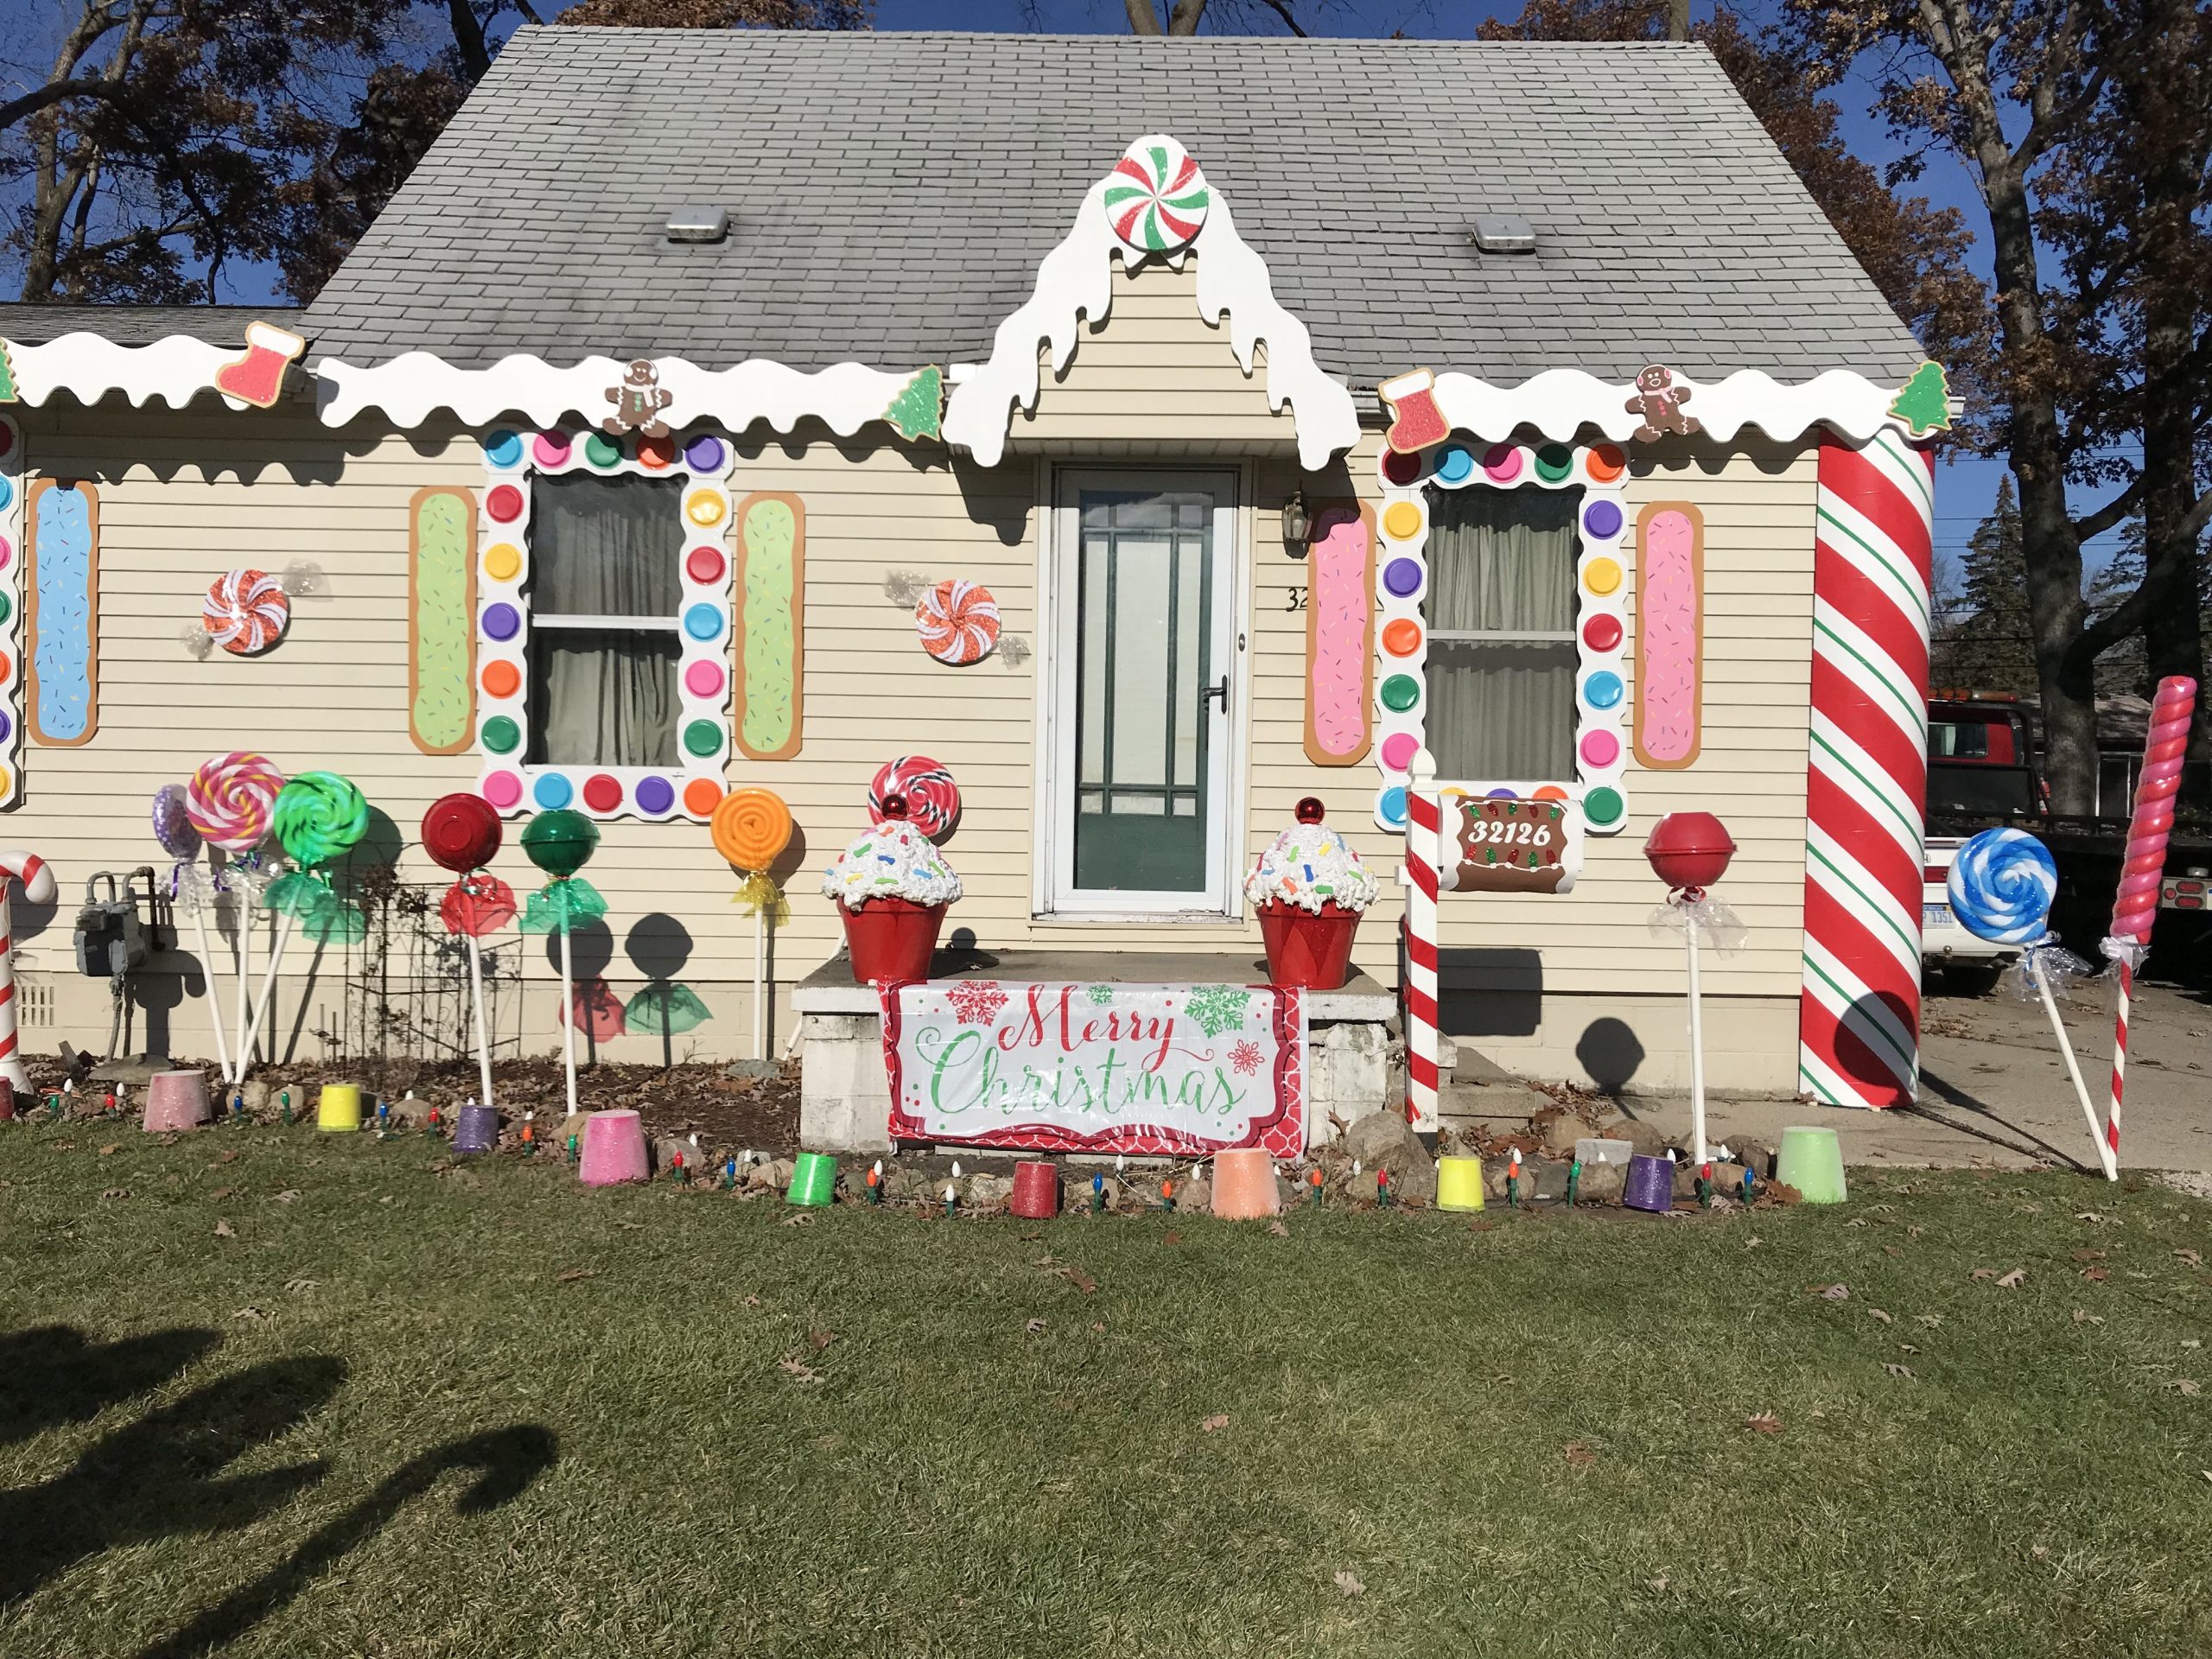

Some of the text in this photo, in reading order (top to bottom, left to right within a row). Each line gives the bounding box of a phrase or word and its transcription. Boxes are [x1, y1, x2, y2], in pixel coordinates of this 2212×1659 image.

[1467, 820, 1552, 847] 32126
[915, 1026, 1247, 1116] Christmas
[998, 983, 1215, 1073] Merry
